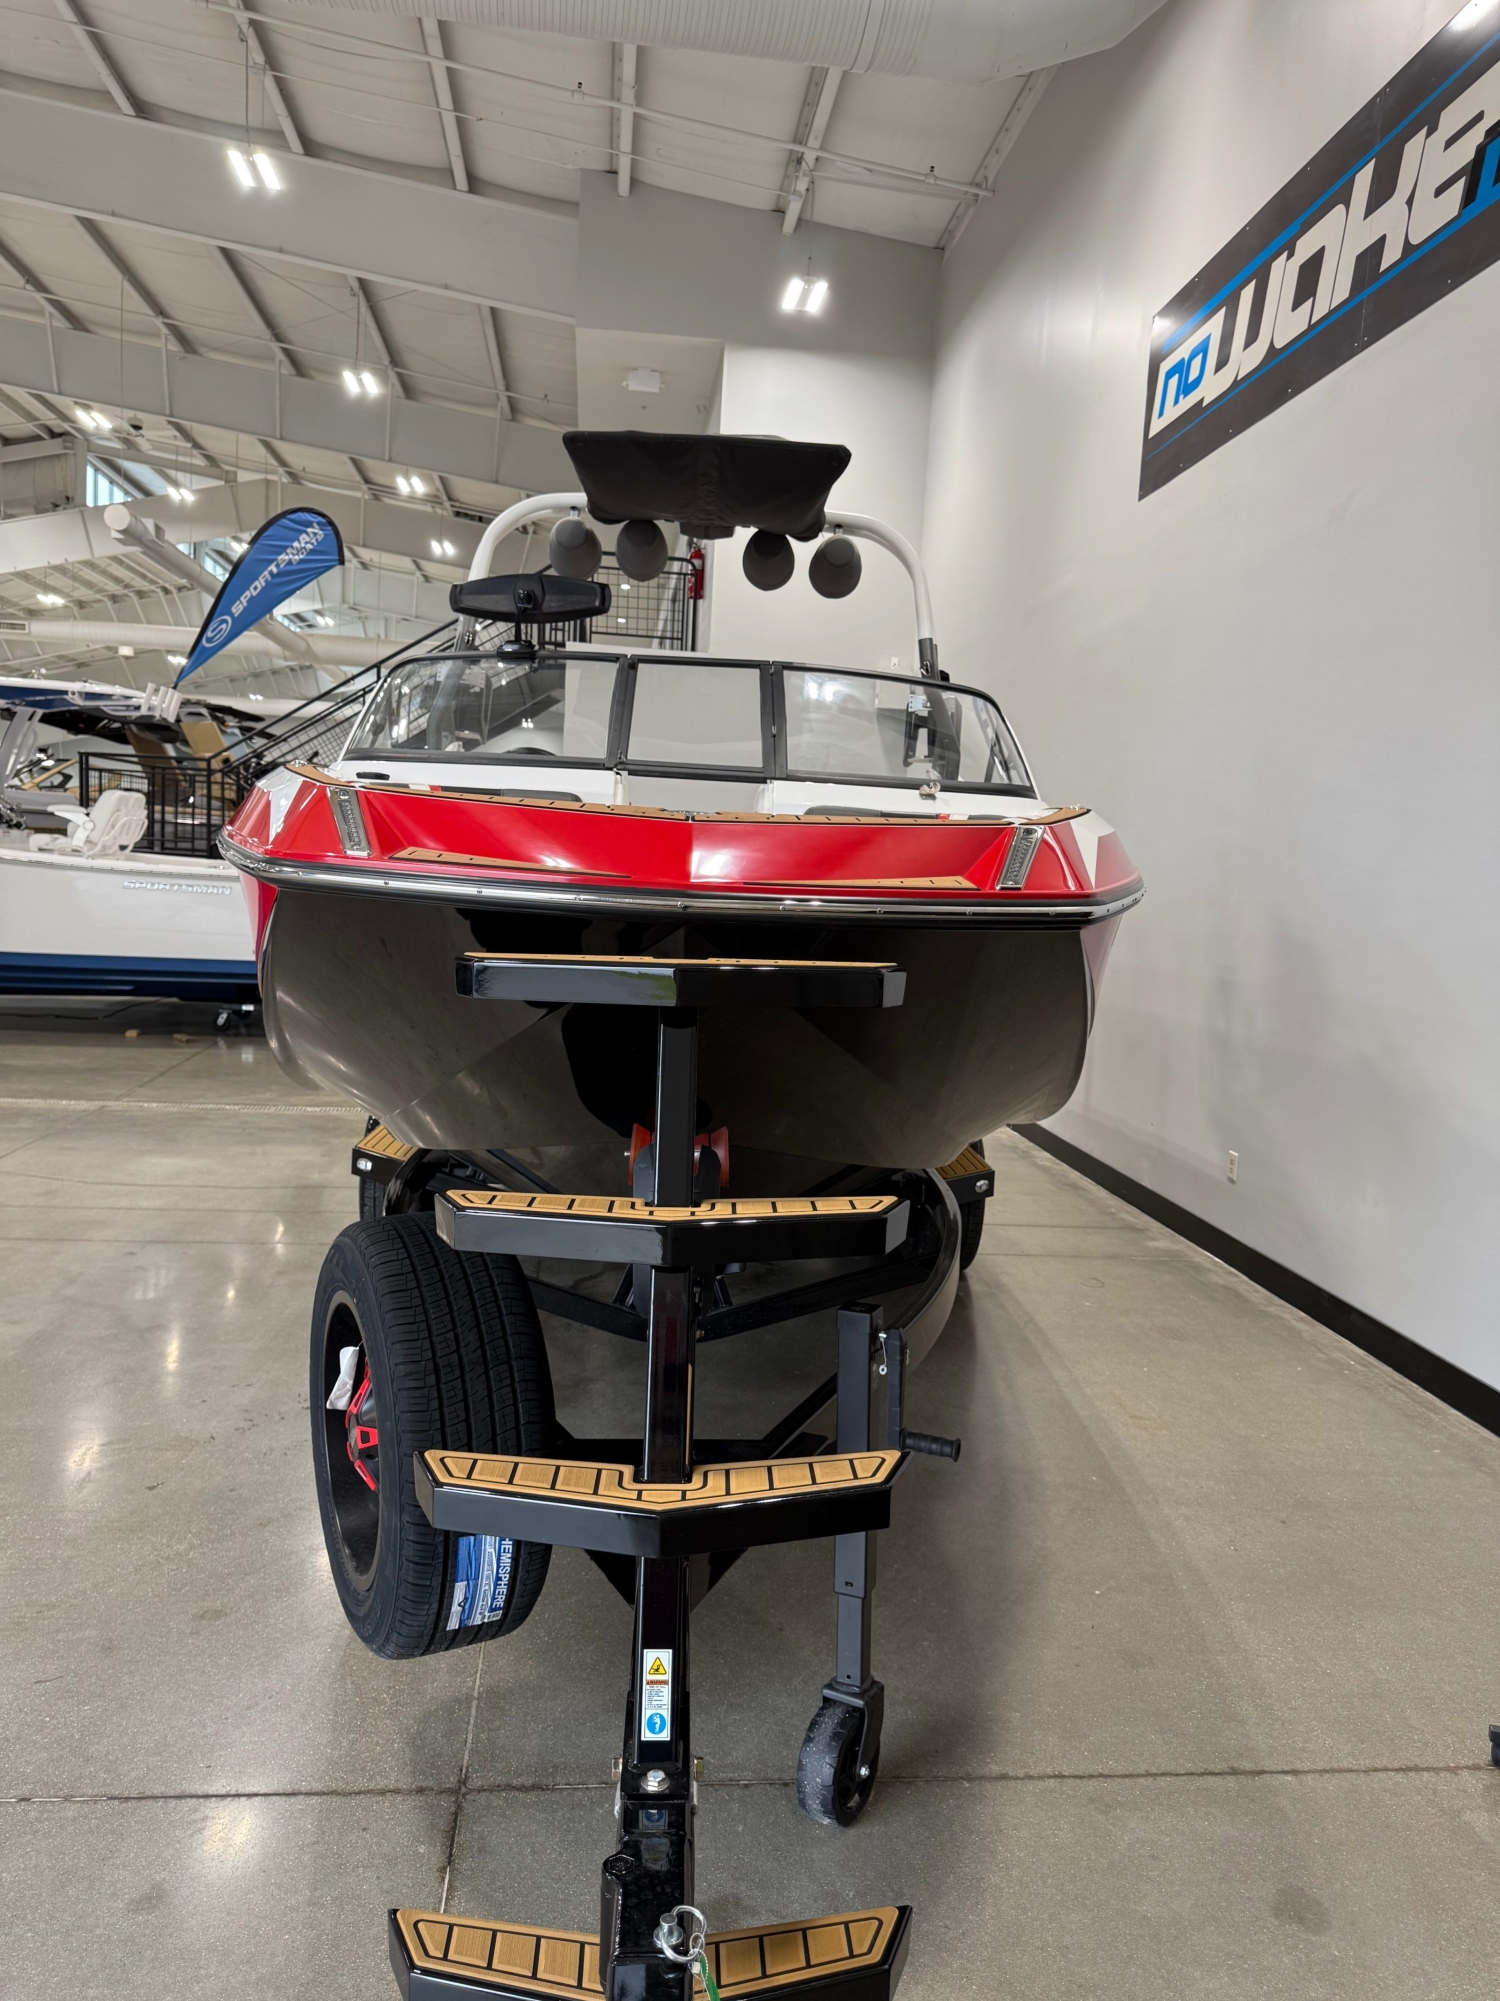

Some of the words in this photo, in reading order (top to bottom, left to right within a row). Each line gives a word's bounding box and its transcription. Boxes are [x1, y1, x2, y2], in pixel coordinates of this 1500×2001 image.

[292, 530, 325, 565] BOATS
[231, 522, 321, 617] SPORTSMAN
[123, 880, 232, 895] SPORTSMAN
